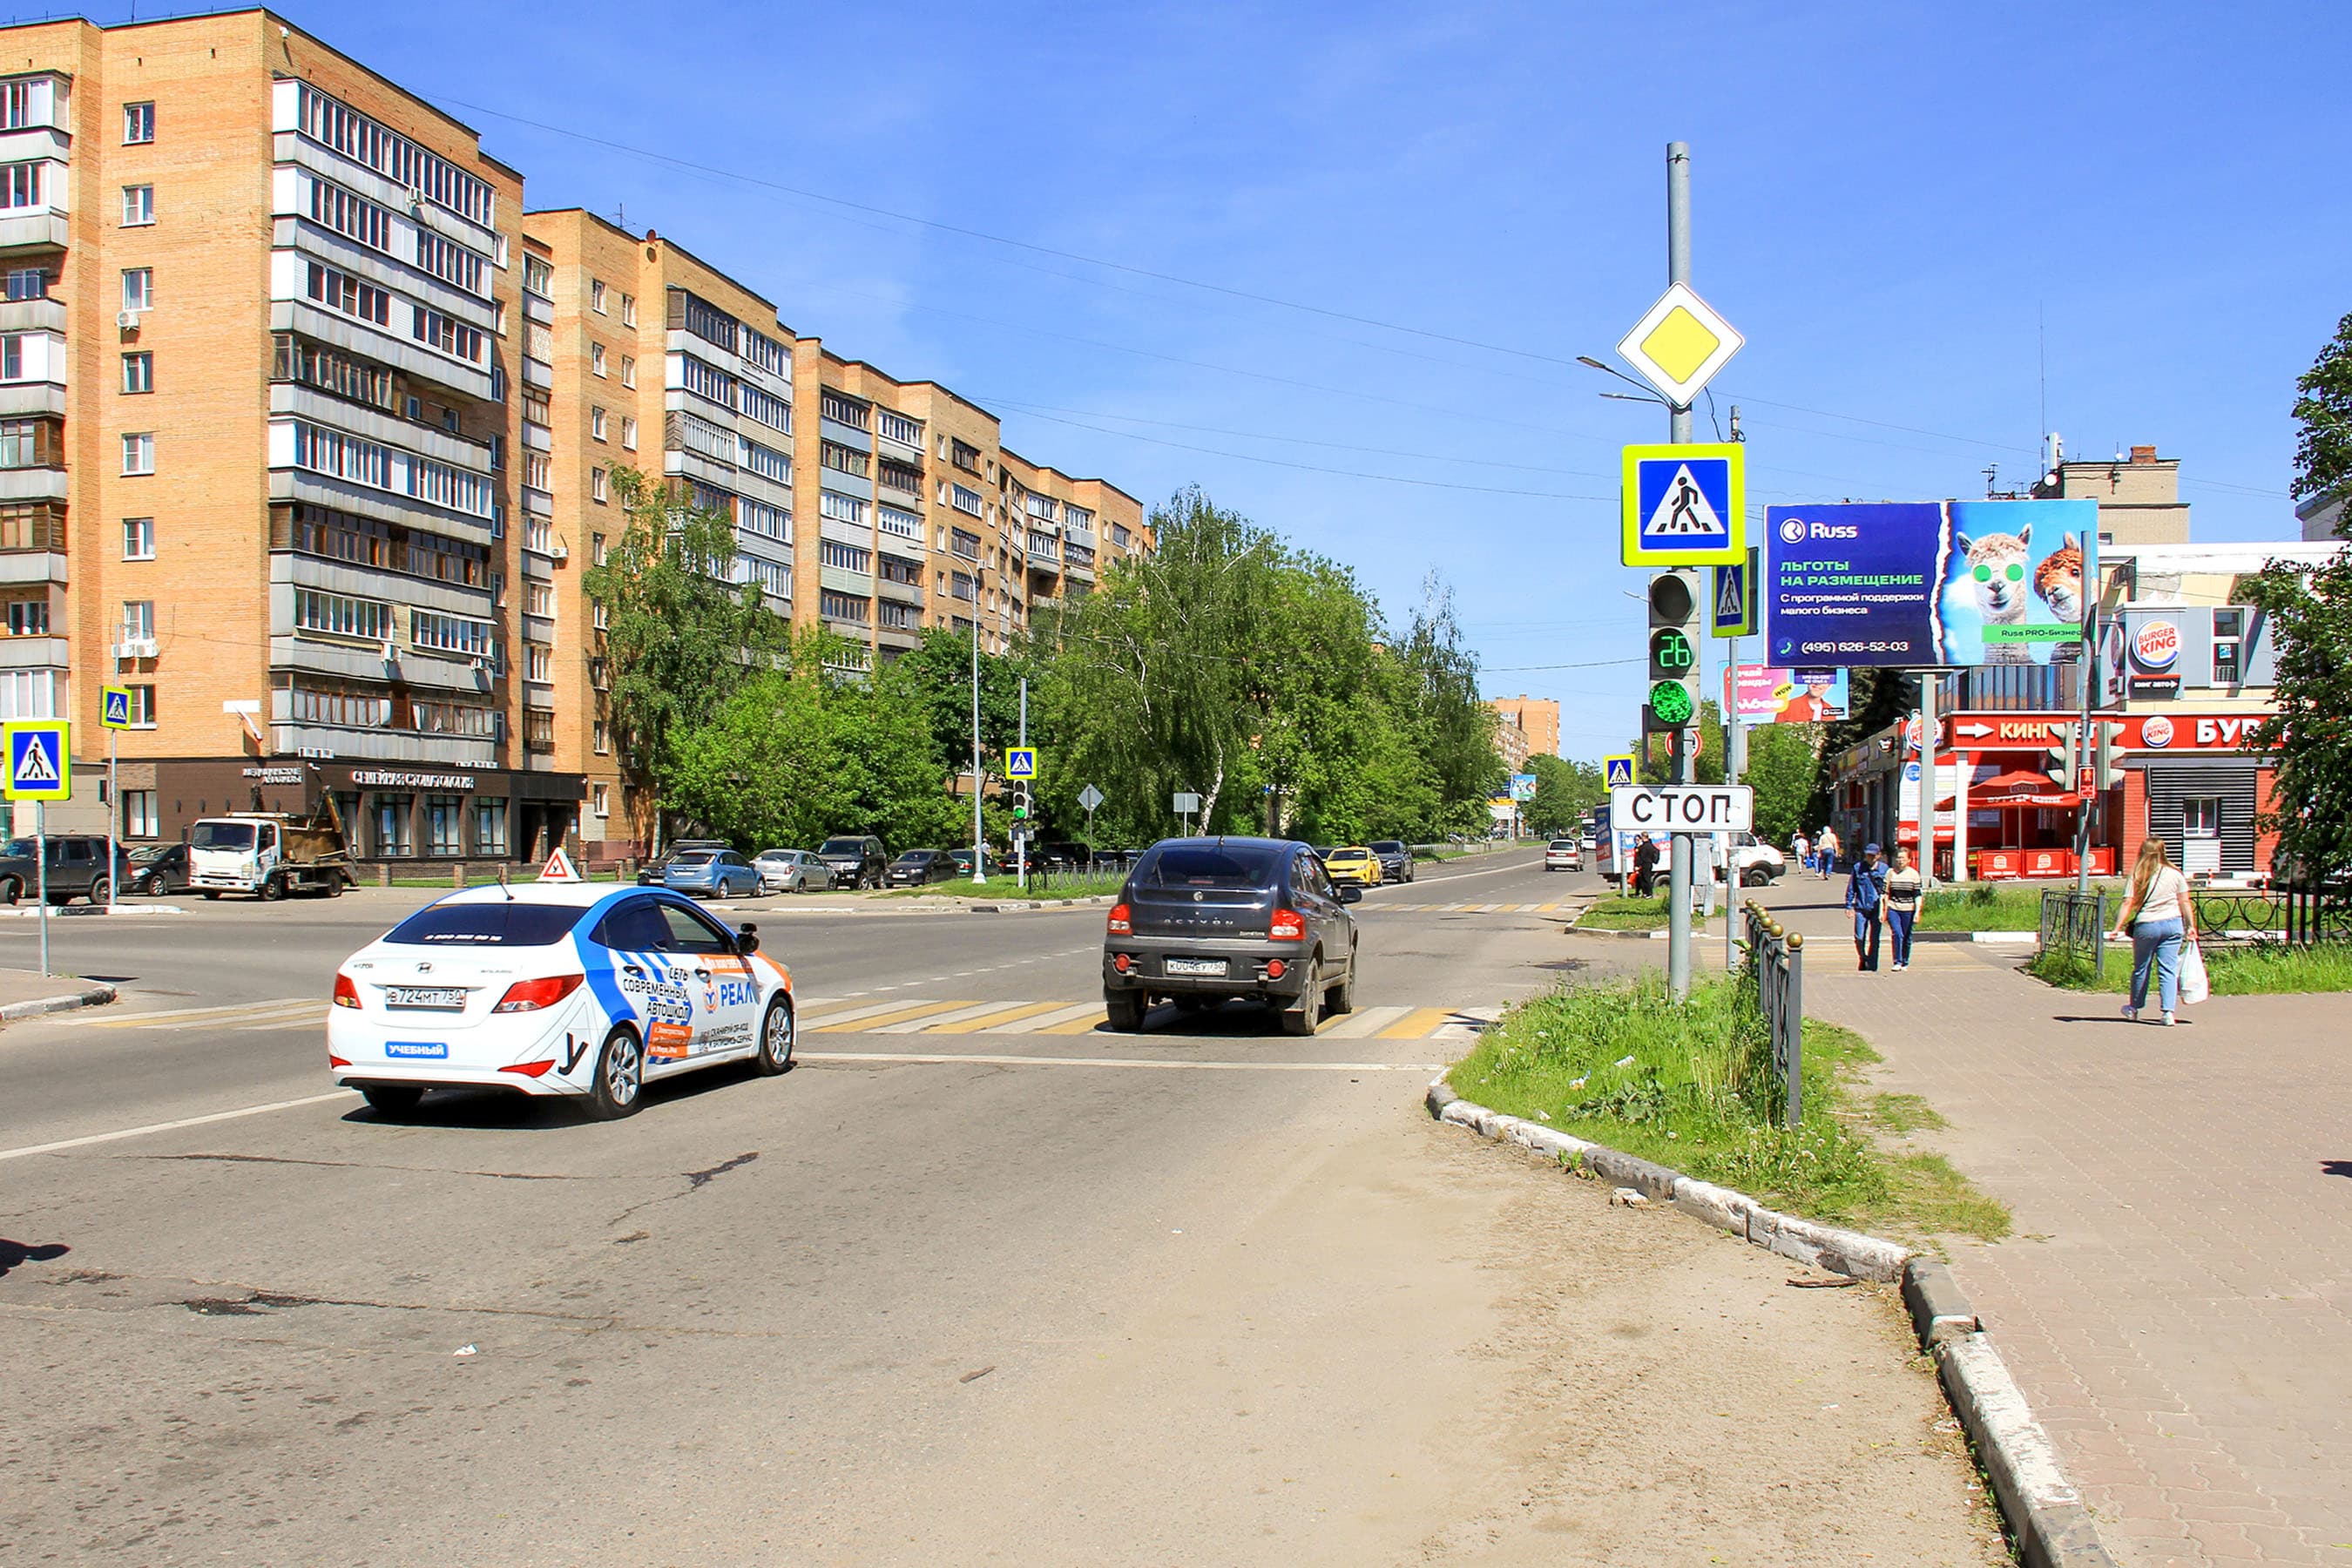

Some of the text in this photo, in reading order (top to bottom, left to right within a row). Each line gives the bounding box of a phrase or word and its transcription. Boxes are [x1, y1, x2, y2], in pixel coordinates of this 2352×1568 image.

[1810, 523, 1858, 538] Russ
[1781, 562, 1849, 571] ЛЬГОТЫ
[1781, 575, 1923, 586] НА РАЗМЕЩЕНИЕ
[1780, 593, 1924, 604] С программой поддержки
[1821, 606, 1869, 615] бизнеса
[2139, 627, 2175, 644] BURGER
[1659, 635, 1691, 667] 26
[1801, 641, 1909, 654] (495) 626-52-03
[2139, 636, 2177, 656] KING
[2000, 722, 2053, 740] КИНГ
[2146, 727, 2171, 739] KING
[1632, 794, 1731, 823] СТОП
[669, 967, 688, 981] СЕТЬ
[623, 978, 688, 999] СОВРЕМЕННЫХ
[720, 982, 754, 1006] РЕАЛ
[646, 1002, 689, 1019] АВТОШКОЛ
[389, 1044, 444, 1056] УЧЕБНЫЙ
[558, 1031, 589, 1076] У
